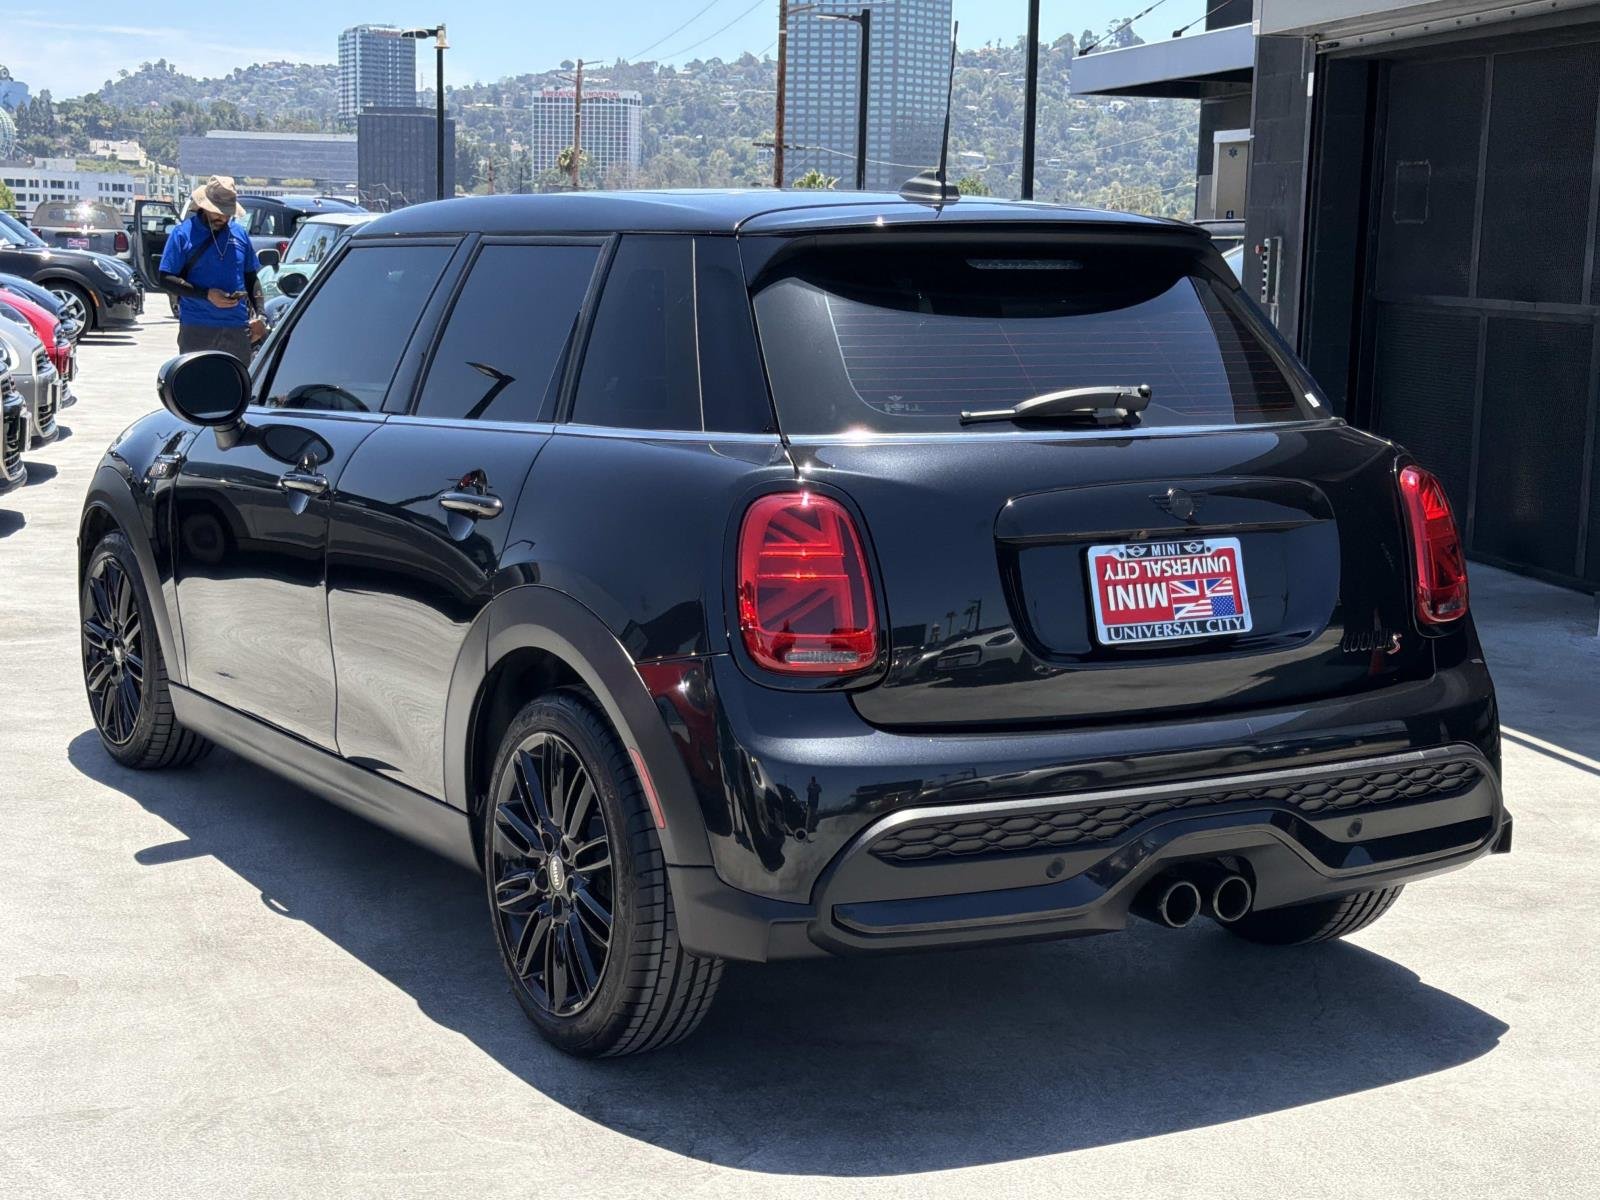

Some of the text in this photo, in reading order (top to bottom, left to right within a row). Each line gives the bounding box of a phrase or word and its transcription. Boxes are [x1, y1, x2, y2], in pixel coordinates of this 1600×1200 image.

[1151, 544, 1180, 556] MINI
[1104, 556, 1231, 581] UNIVERSAL CITY
[1107, 582, 1168, 611] MINI
[1110, 617, 1242, 640] UNIVERSAL CITY
